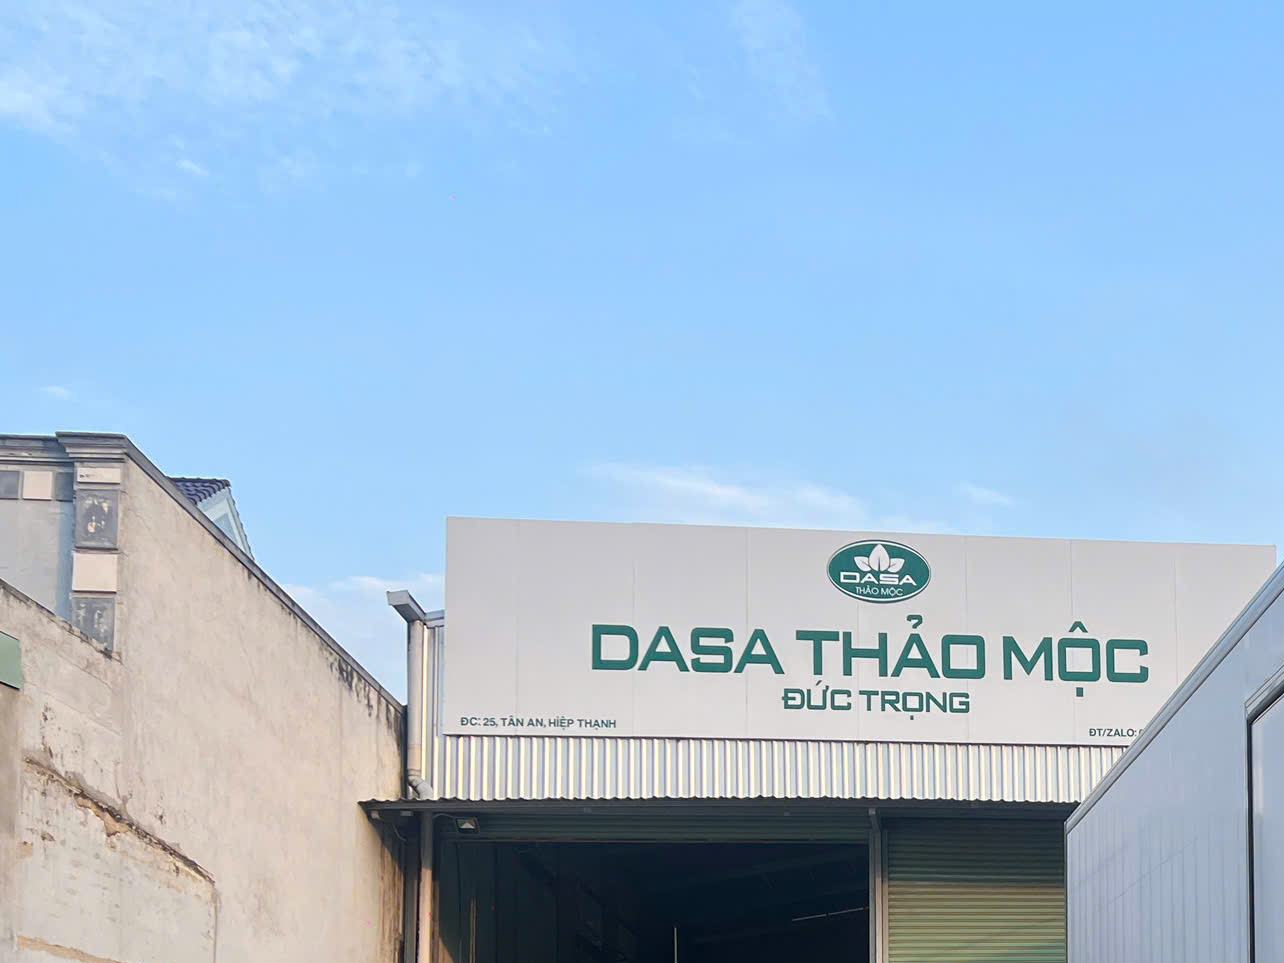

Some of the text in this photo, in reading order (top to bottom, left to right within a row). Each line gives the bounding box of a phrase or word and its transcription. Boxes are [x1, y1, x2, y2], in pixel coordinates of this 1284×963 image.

[840, 571, 917, 586] DASA
[856, 585, 904, 597] THẢO MỘC
[592, 614, 1149, 697] DASA THẢO MỘC
[782, 680, 970, 721] ĐỨC TRỌNG
[460, 716, 481, 727] ĐC:
[483, 716, 498, 728] 25,
[500, 715, 524, 727] TÂN
[527, 717, 546, 729] AN,
[577, 718, 617, 731] THẠNH
[1088, 728, 1137, 738] ĐT/ZALO:
